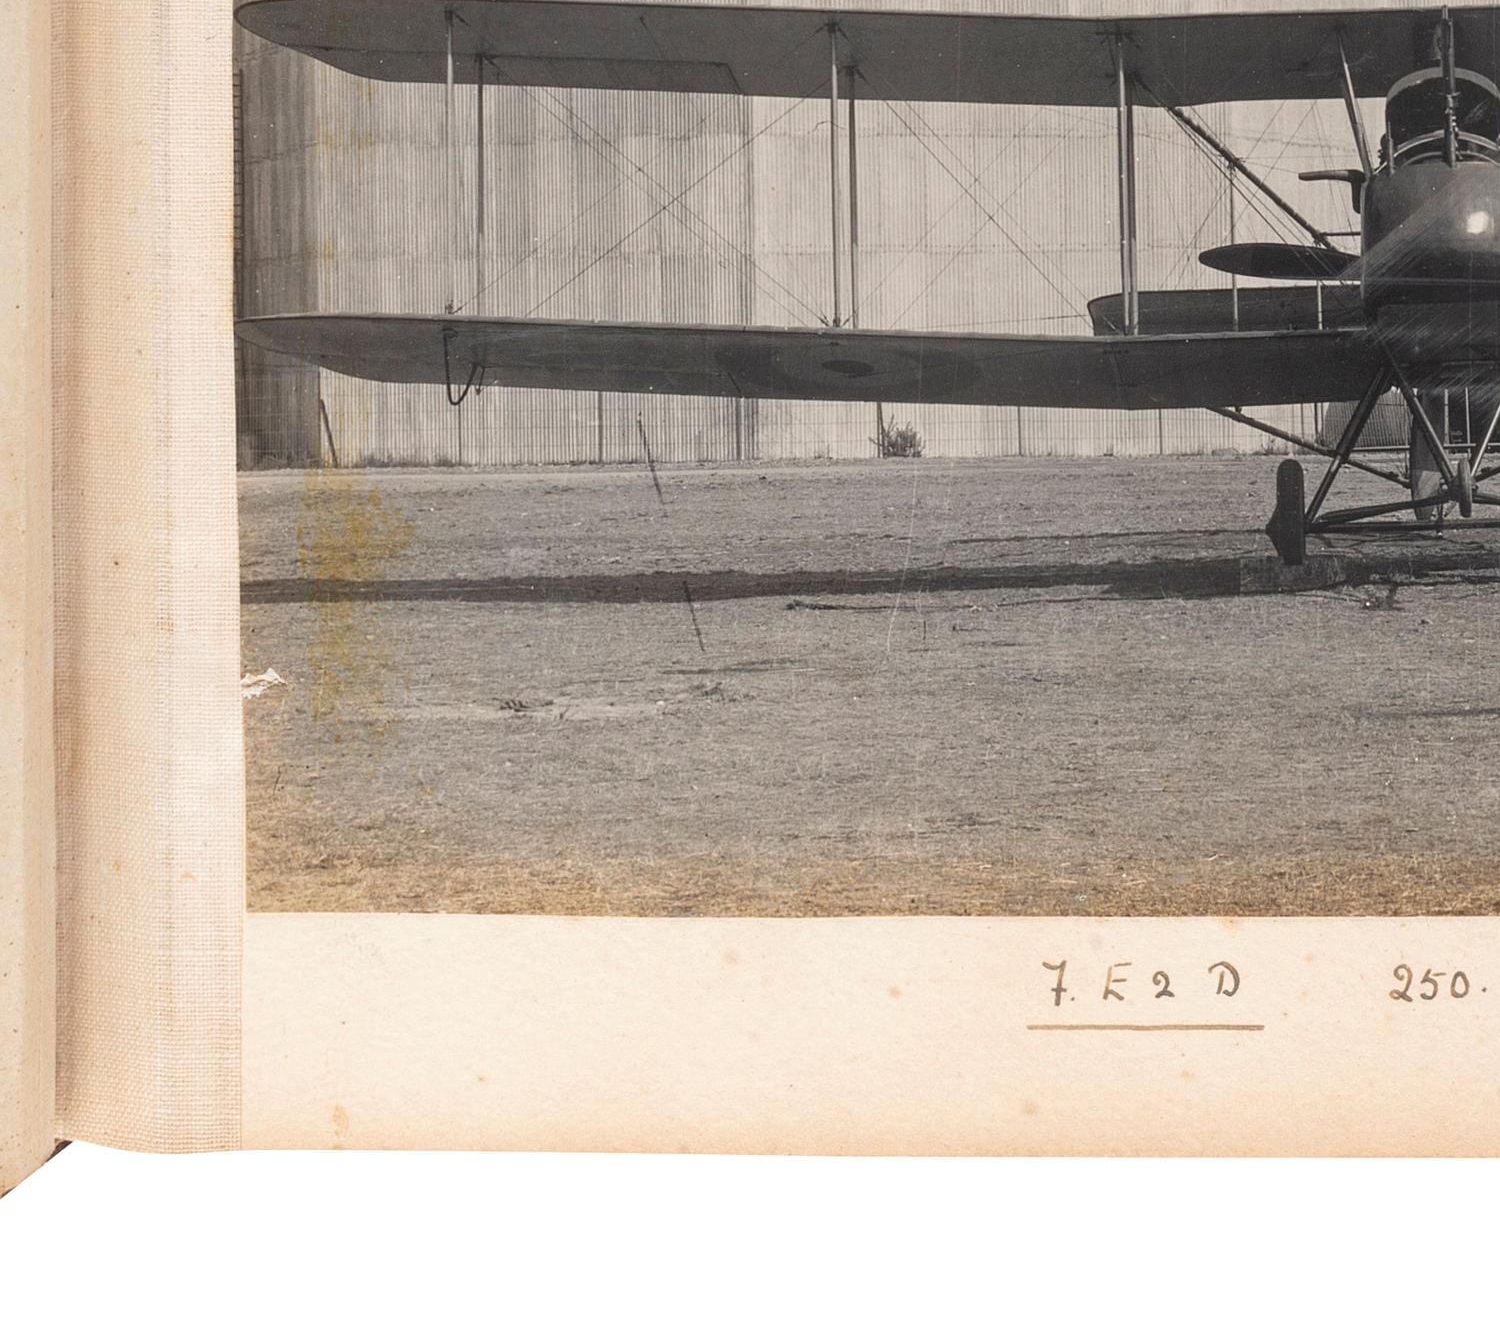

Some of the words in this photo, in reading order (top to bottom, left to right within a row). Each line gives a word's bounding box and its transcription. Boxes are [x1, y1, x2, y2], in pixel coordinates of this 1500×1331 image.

[1102, 962, 1132, 1002] E
[1151, 970, 1176, 999] 2
[1207, 960, 1241, 998] D
